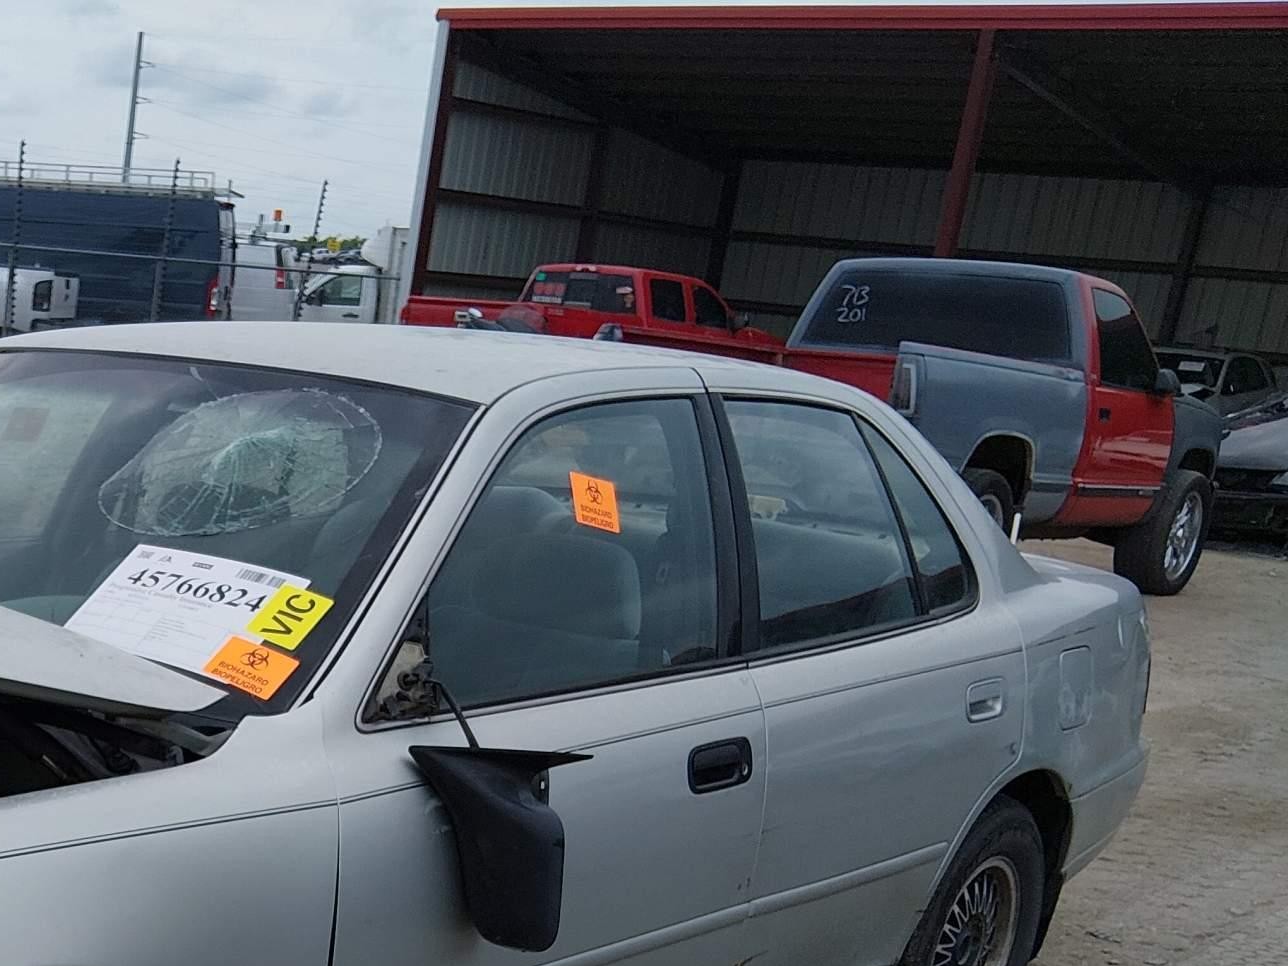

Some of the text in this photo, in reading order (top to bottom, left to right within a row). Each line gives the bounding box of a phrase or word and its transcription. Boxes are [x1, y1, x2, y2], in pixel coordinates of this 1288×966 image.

[836, 307, 867, 323] 201
[127, 567, 268, 612] 45766824
[259, 594, 316, 635] VIC
